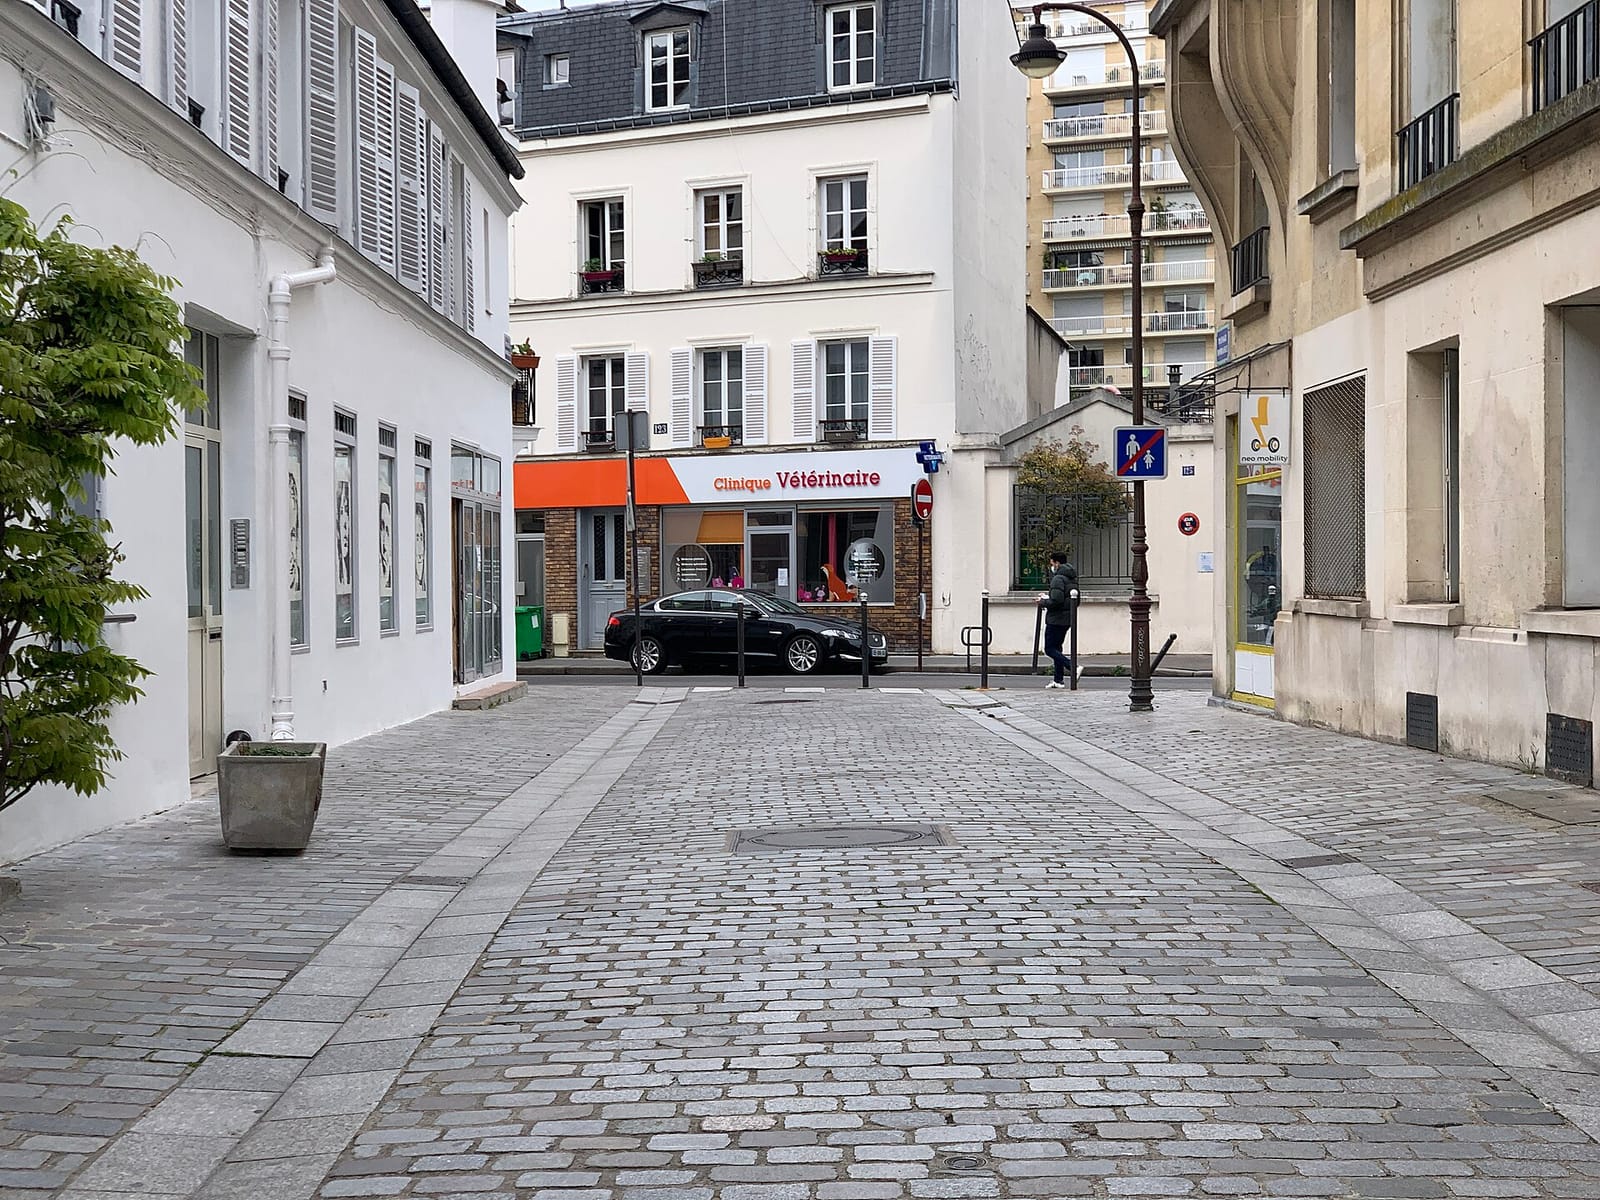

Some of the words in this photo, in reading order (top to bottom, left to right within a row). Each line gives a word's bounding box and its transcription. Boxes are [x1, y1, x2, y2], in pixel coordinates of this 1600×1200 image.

[1257, 455, 1287, 463] mobility
[714, 477, 771, 493] Clinique
[776, 470, 881, 488] Vétérinaire
